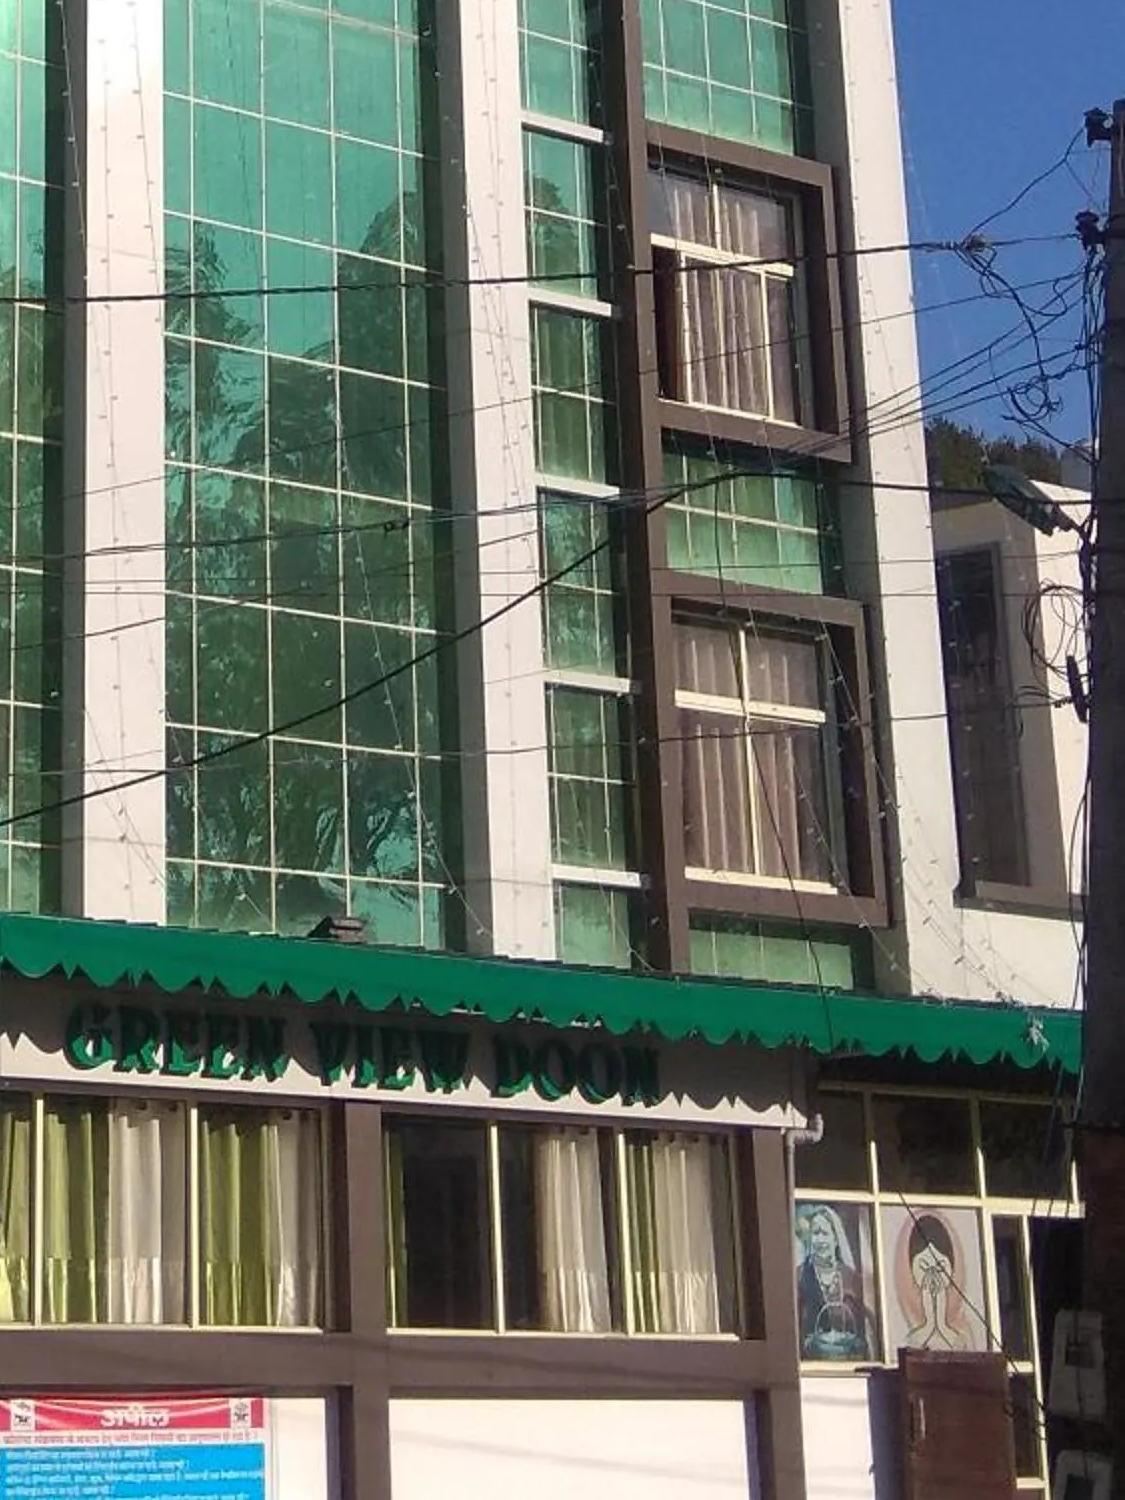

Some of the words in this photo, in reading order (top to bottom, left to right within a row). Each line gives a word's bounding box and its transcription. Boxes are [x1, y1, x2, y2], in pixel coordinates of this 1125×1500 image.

[65, 1004, 286, 1082] GREEN
[309, 1022, 472, 1095] VIEW
[489, 1032, 660, 1108] DOON
